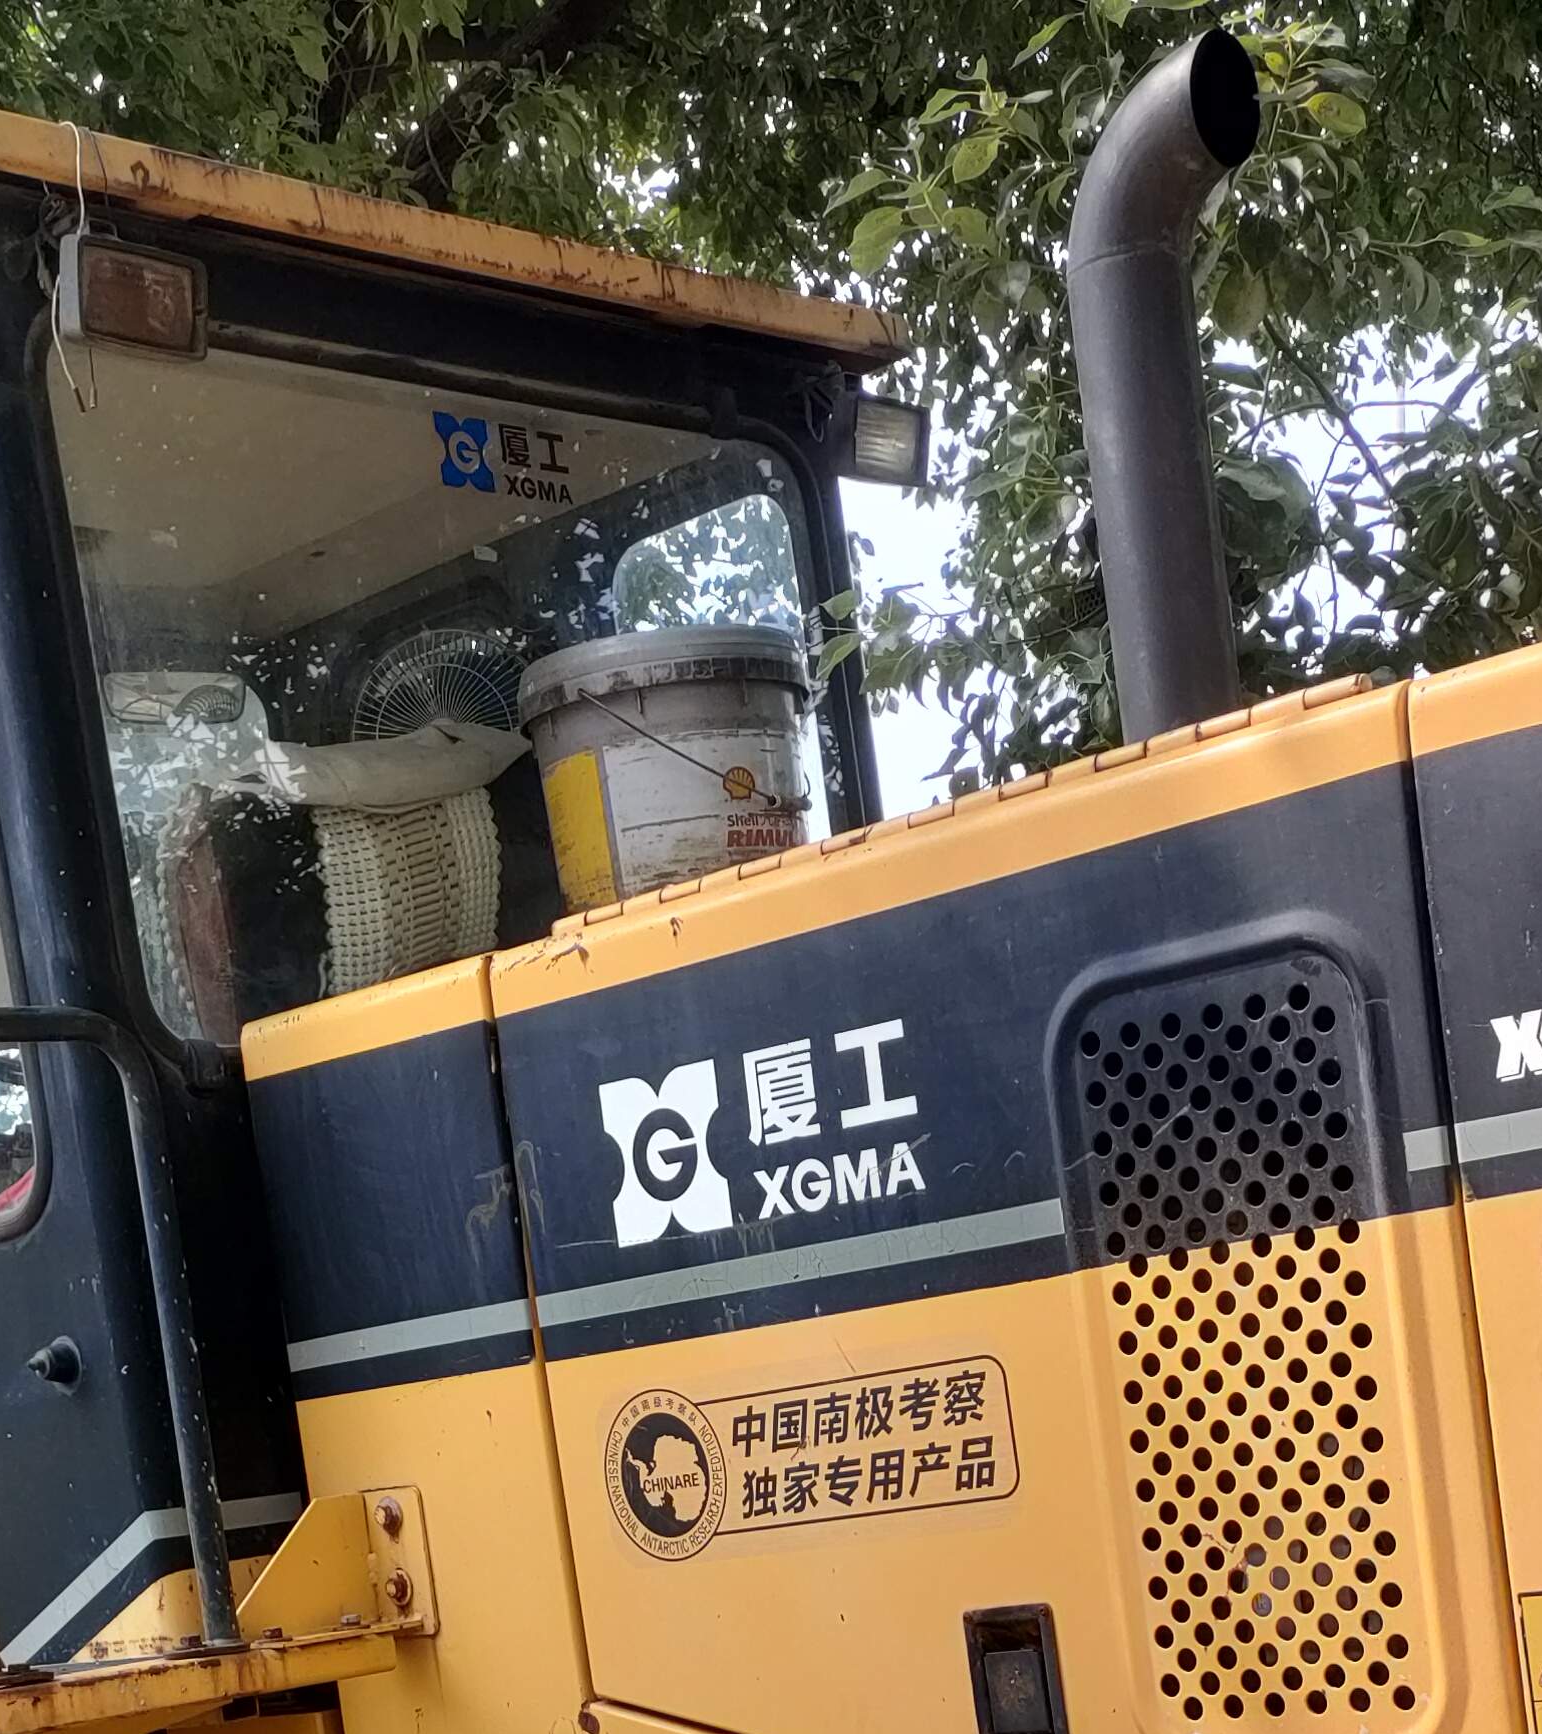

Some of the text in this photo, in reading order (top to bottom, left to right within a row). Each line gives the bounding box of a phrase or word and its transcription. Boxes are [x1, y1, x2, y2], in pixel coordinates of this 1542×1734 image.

[499, 423, 569, 474] 厦工
[504, 474, 573, 505] XGMA
[727, 813, 759, 827] Shell
[727, 829, 805, 848] RIMUL
[743, 1018, 919, 1146] 厦工
[754, 1141, 926, 1219] XGMA
[731, 1370, 987, 1459] 中国南极考察
[608, 1424, 724, 1556] CHINESE NATIONAL ANTARCTIC RESEARCH EXPEDITION
[643, 1472, 700, 1494] CHINARE
[741, 1434, 996, 1520] 独家专用产品
